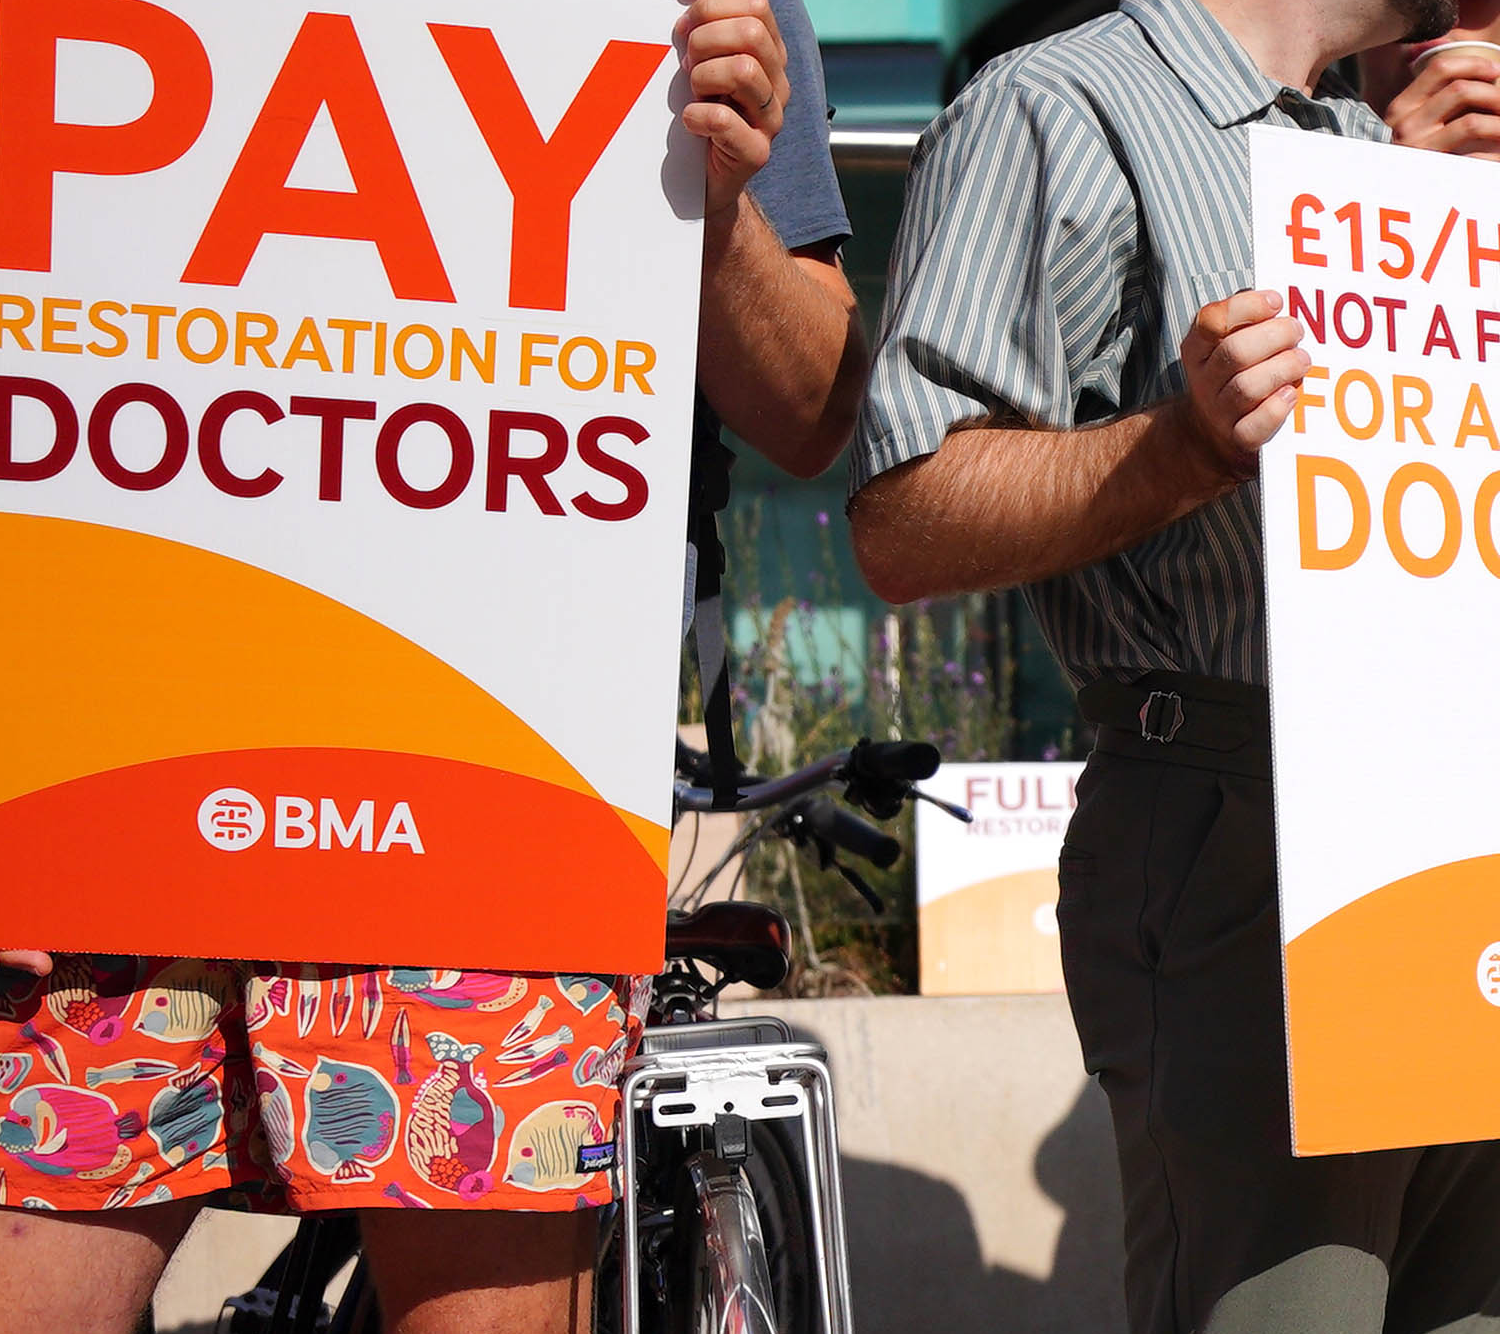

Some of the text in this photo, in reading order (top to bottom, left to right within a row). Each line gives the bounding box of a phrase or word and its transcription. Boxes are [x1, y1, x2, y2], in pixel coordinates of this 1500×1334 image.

[1286, 285, 1401, 352] NOT
[1422, 307, 1461, 359] A
[520, 333, 657, 394] FOR
[1294, 366, 1436, 447] FOR
[1455, 388, 1500, 450] A
[274, 795, 425, 855] BMA
[965, 818, 1068, 836] RESTOR
